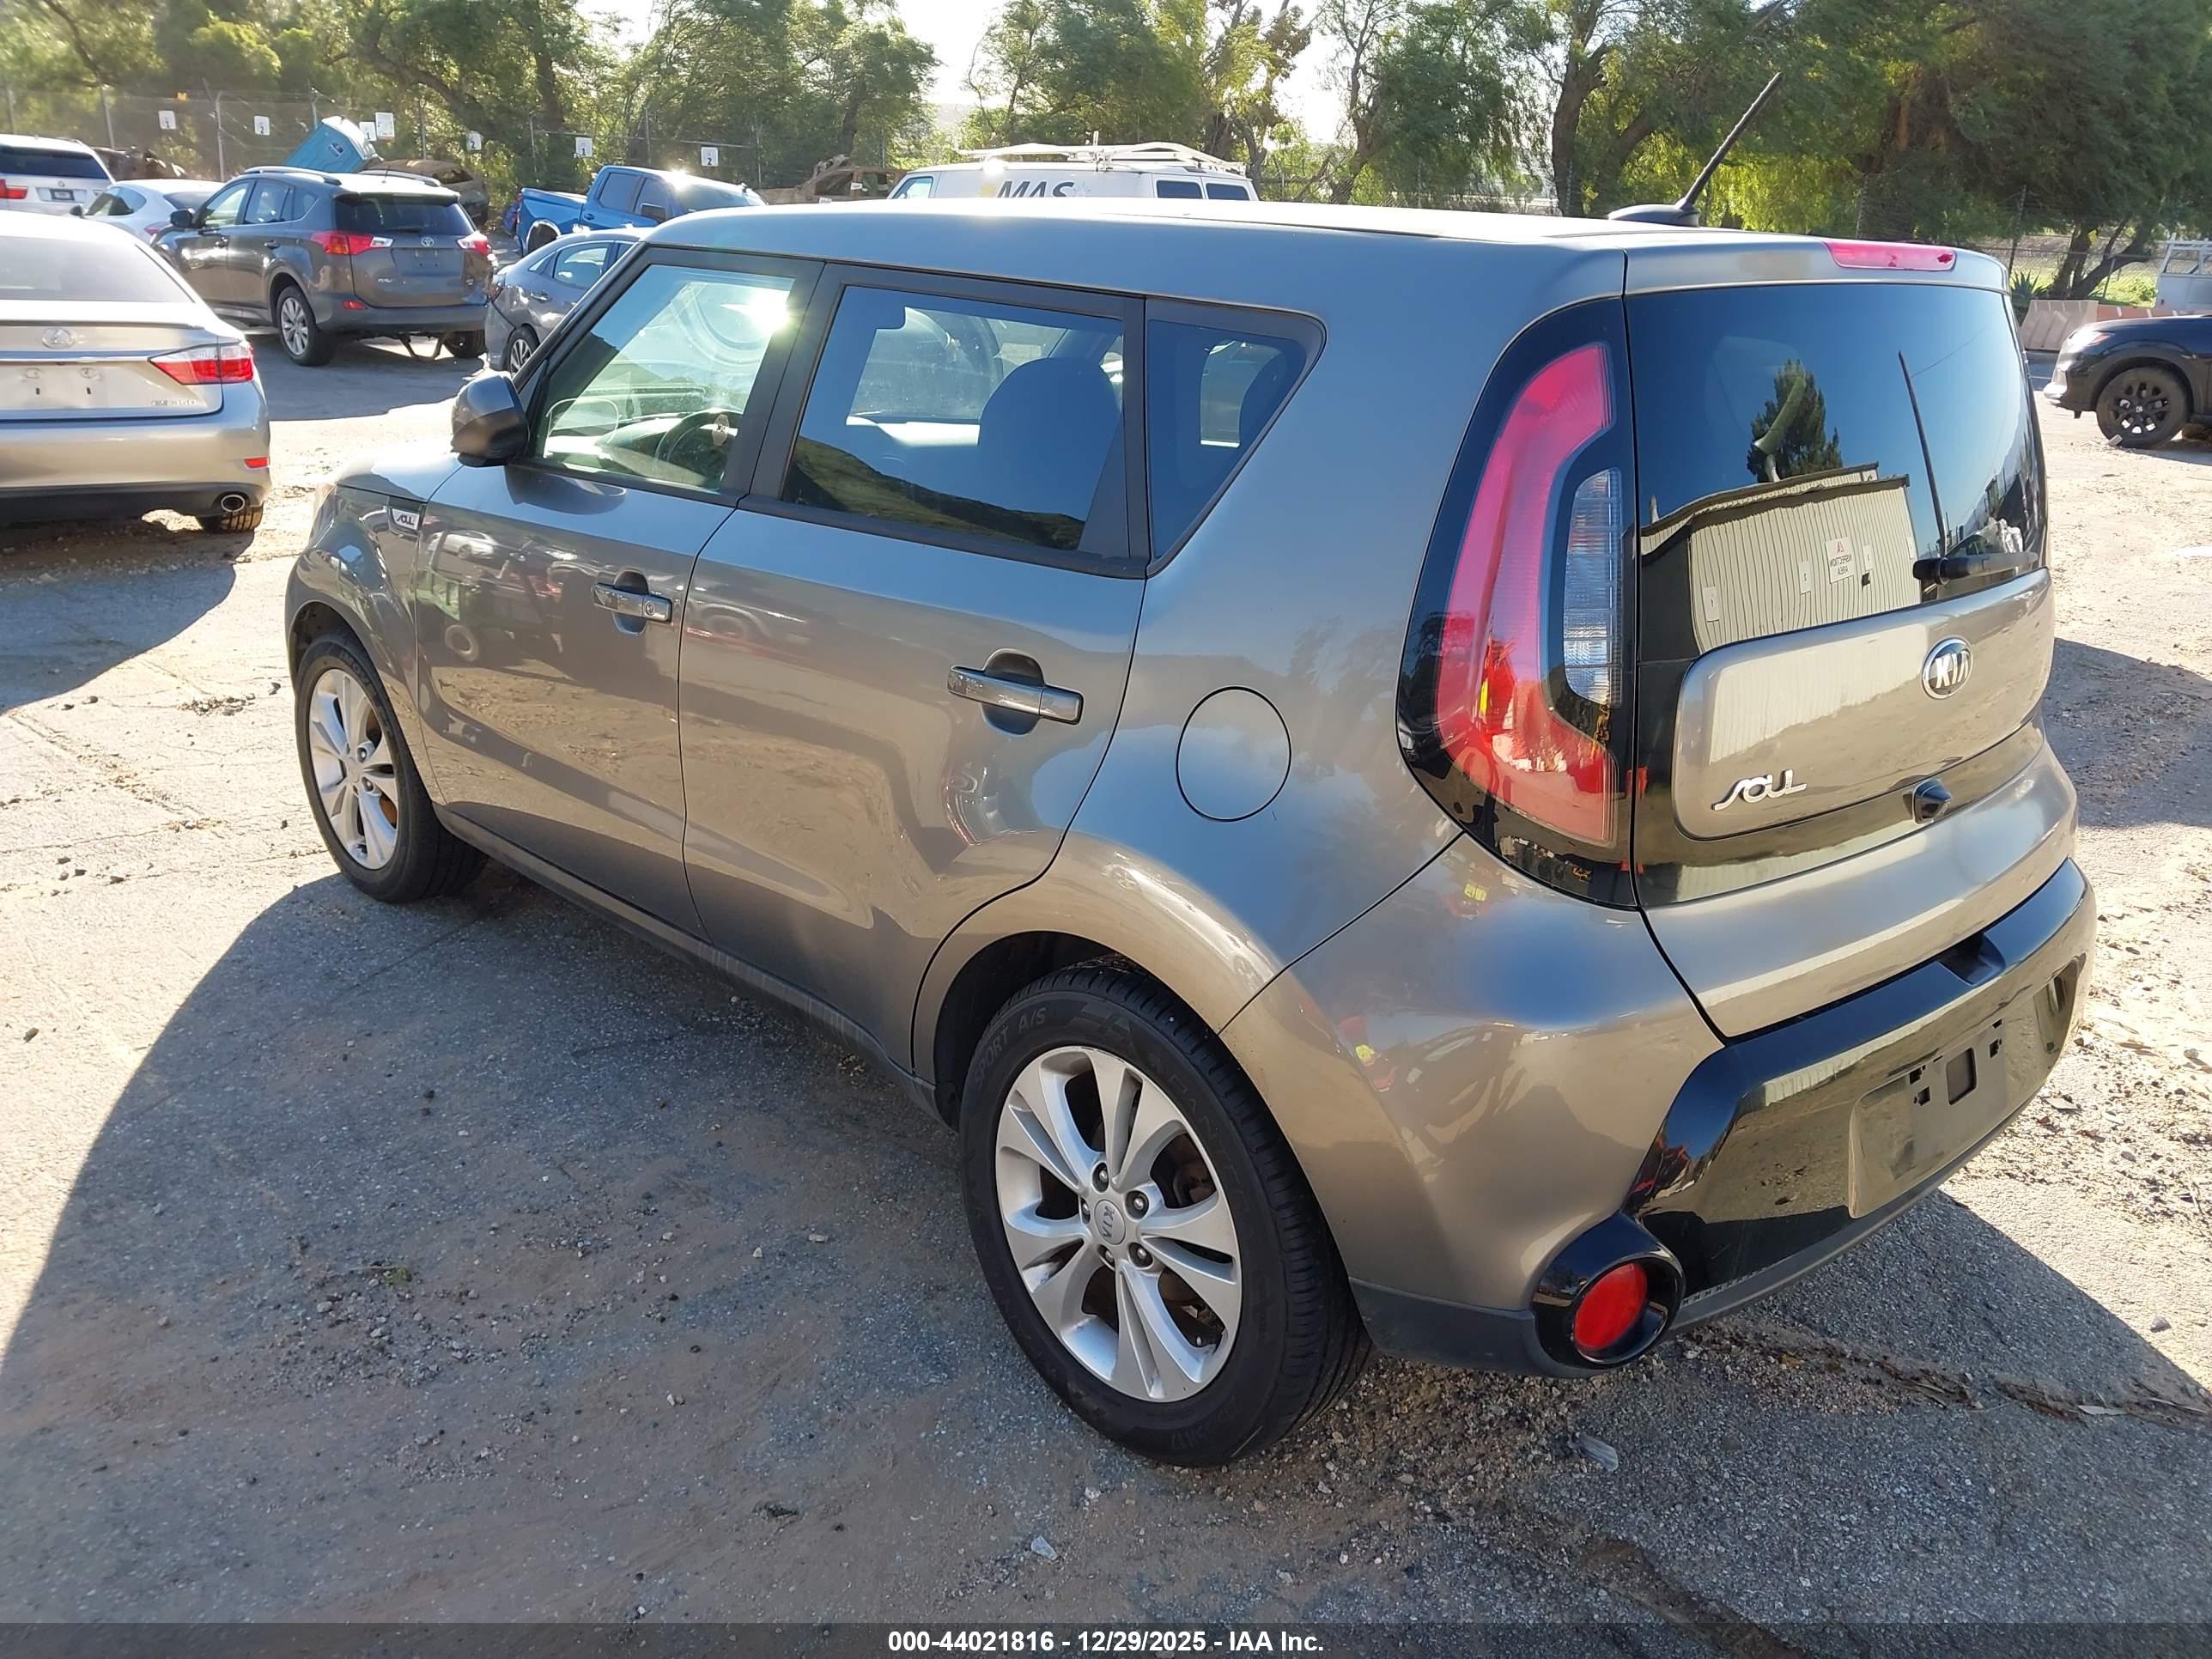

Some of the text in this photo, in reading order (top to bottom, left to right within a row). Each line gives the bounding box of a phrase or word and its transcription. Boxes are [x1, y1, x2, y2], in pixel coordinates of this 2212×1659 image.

[1935, 650, 1969, 689] KIA
[1711, 769, 1808, 811] SOUL
[974, 1006, 1047, 1091] SPORT A/S
[1103, 1206, 1115, 1238] KIA
